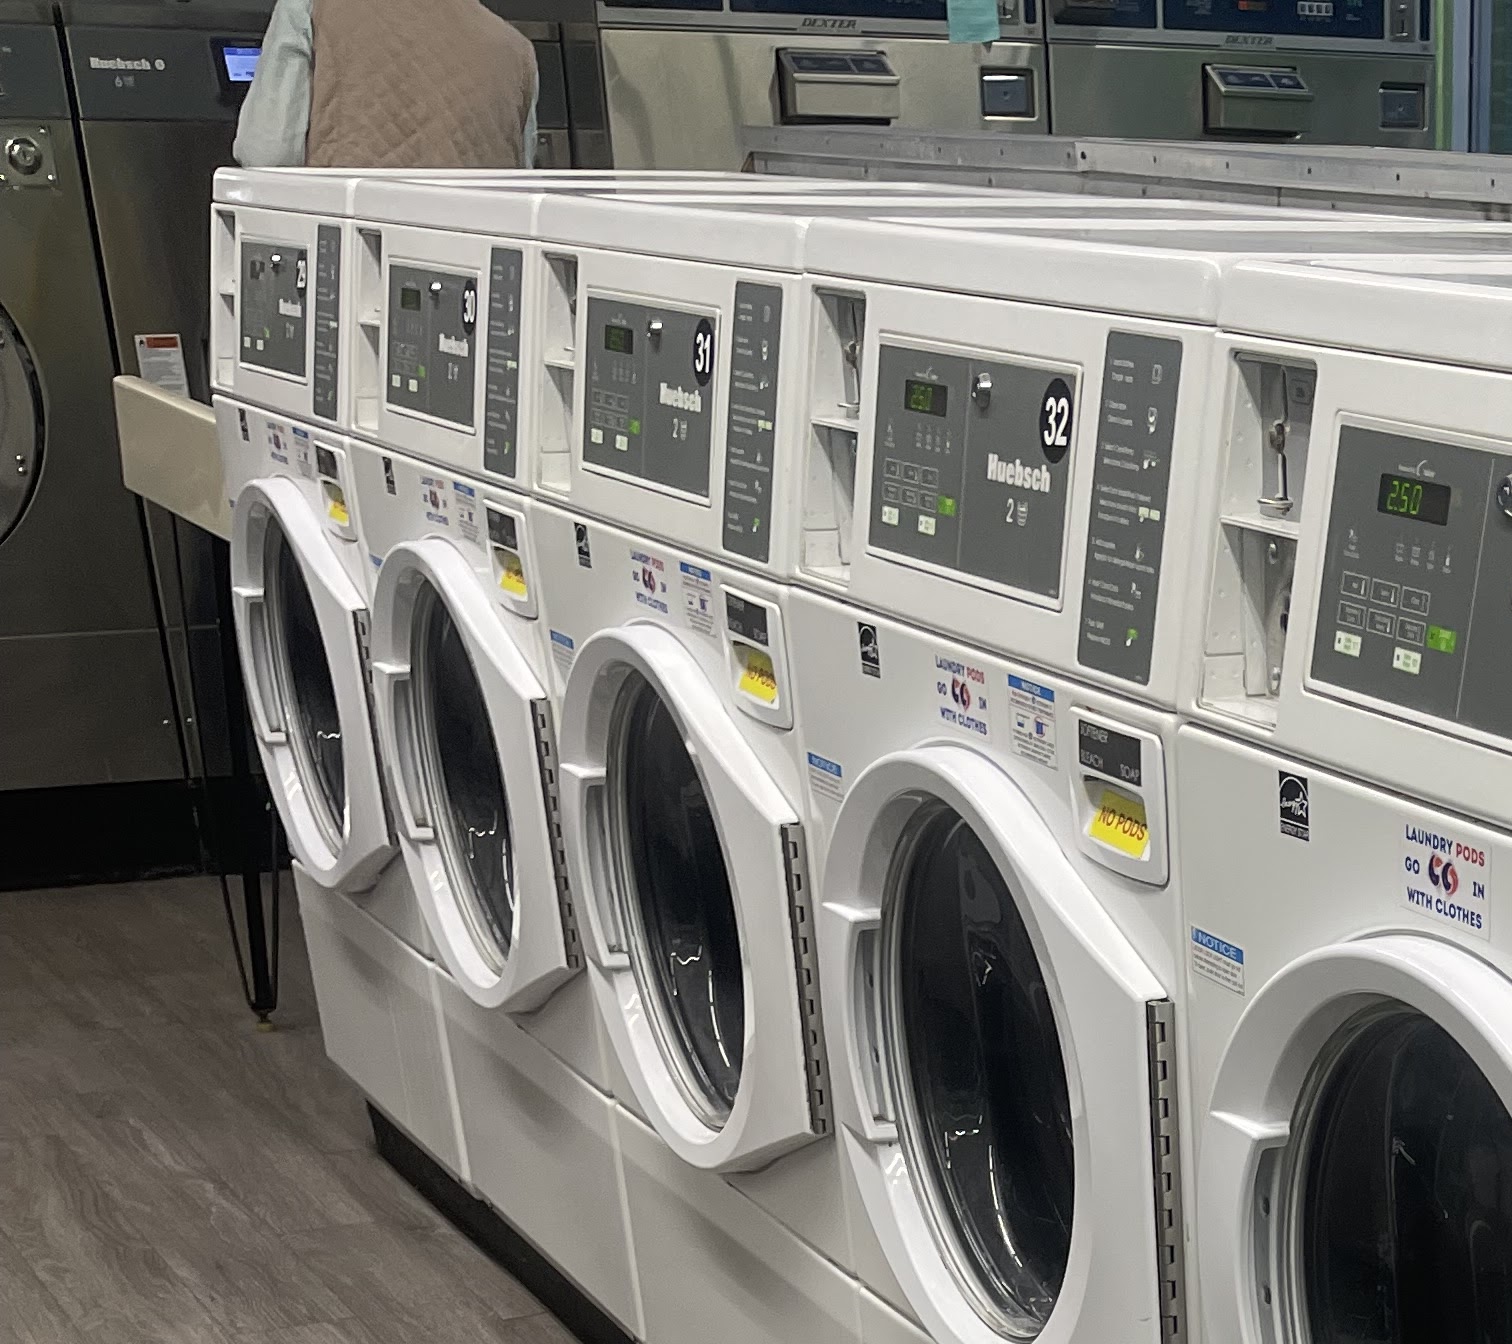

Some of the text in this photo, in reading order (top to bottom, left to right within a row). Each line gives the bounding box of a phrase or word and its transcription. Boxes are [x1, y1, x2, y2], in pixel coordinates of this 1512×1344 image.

[802, 17, 857, 30] DEXTER
[1225, 34, 1274, 46] DEXTER
[695, 332, 711, 374] 31
[1043, 396, 1070, 447] 32
[987, 453, 1051, 493] Huebsch
[1005, 498, 1014, 523] 2
[1386, 480, 1423, 515] 2.50
[935, 654, 985, 685] LAUNDRY PODS
[936, 681, 988, 711] GO IN
[939, 706, 988, 736] WITH CLOTHES
[1119, 763, 1140, 781] SOAP
[1098, 805, 1147, 841] NO PODS
[1405, 824, 1486, 868] LAUNDRY PODS
[1404, 856, 1486, 901] GO IN
[1406, 886, 1483, 930] WITH CLOTHES
[1198, 932, 1238, 960] NOTICE
